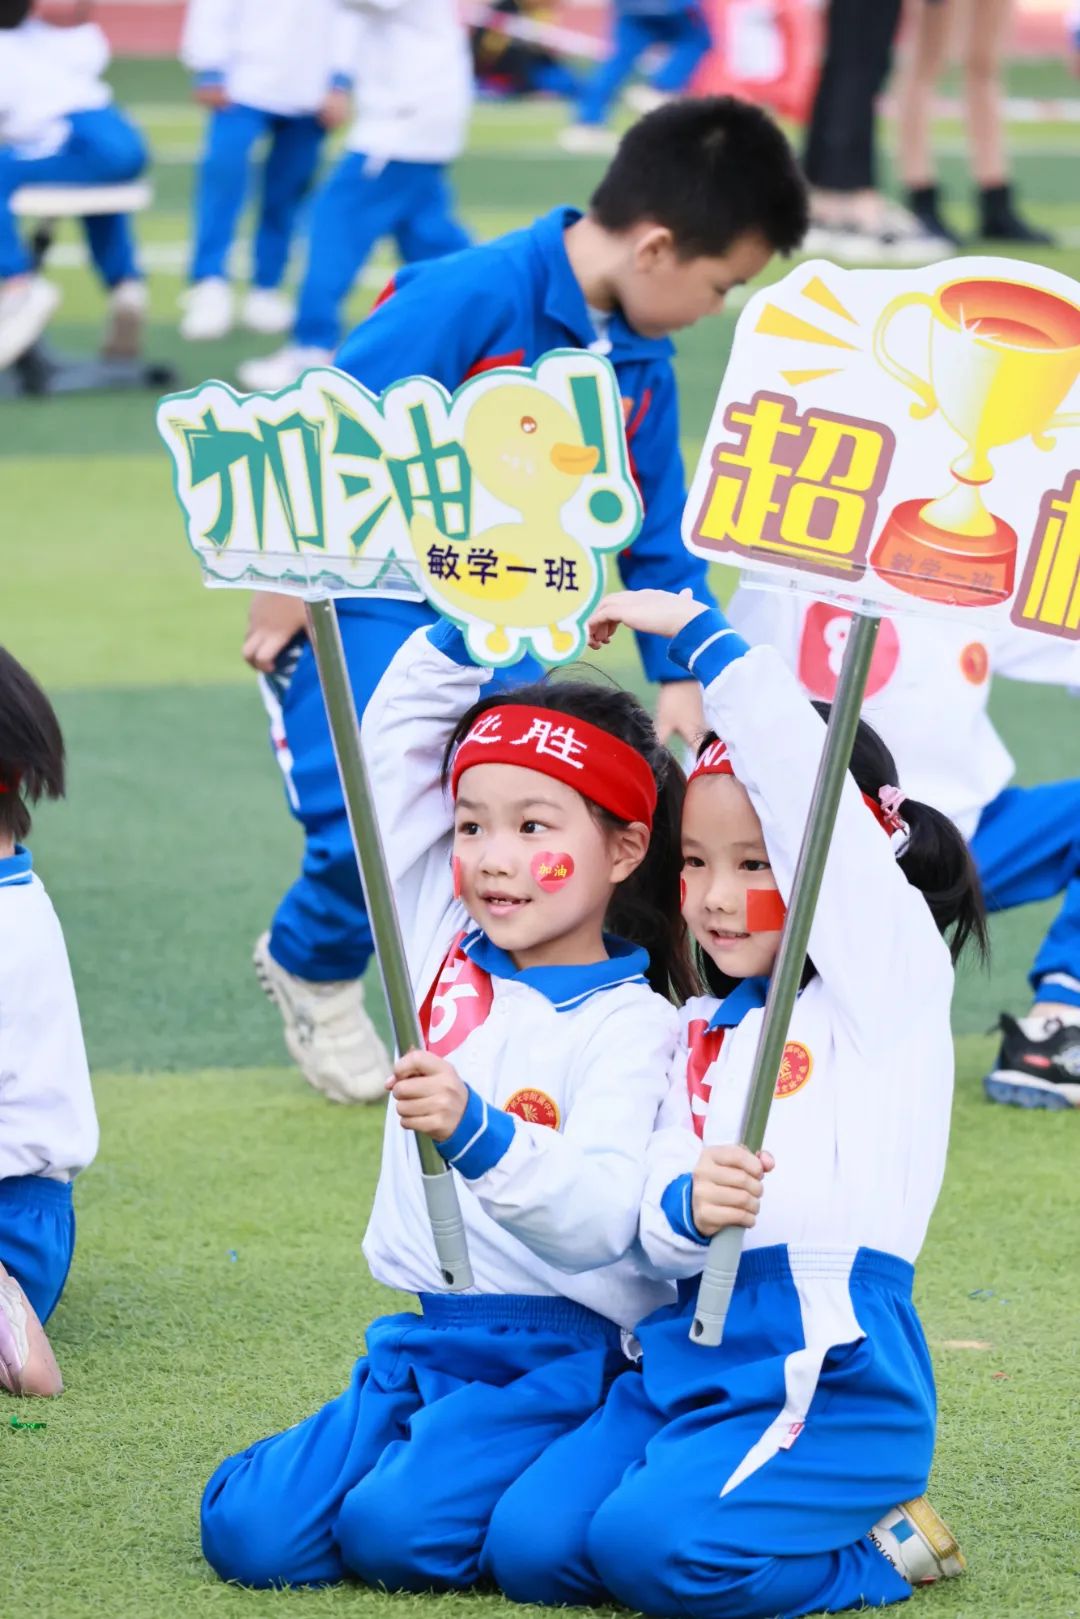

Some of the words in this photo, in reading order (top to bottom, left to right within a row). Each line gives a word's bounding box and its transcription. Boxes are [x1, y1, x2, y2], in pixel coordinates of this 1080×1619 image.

[427, 543, 581, 592] 敏学一班
[453, 713, 588, 770] 必胜
[538, 863, 567, 878] 加油
